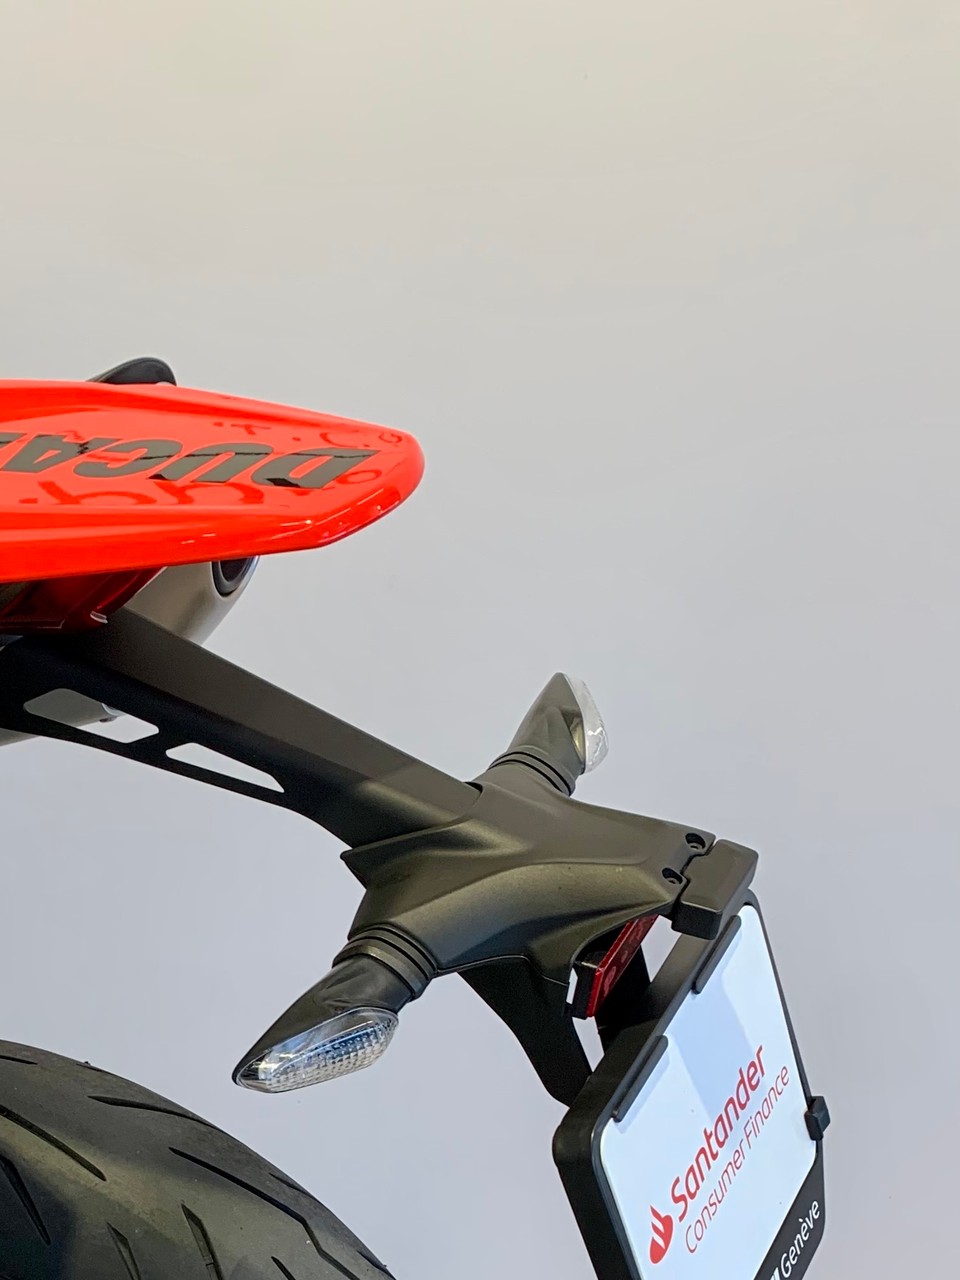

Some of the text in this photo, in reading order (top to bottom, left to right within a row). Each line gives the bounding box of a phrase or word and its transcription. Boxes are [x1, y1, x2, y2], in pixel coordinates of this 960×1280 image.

[671, 1045, 765, 1223] Santander
[685, 1066, 790, 1254] Consumer Finance
[780, 1201, 821, 1279] Genève
